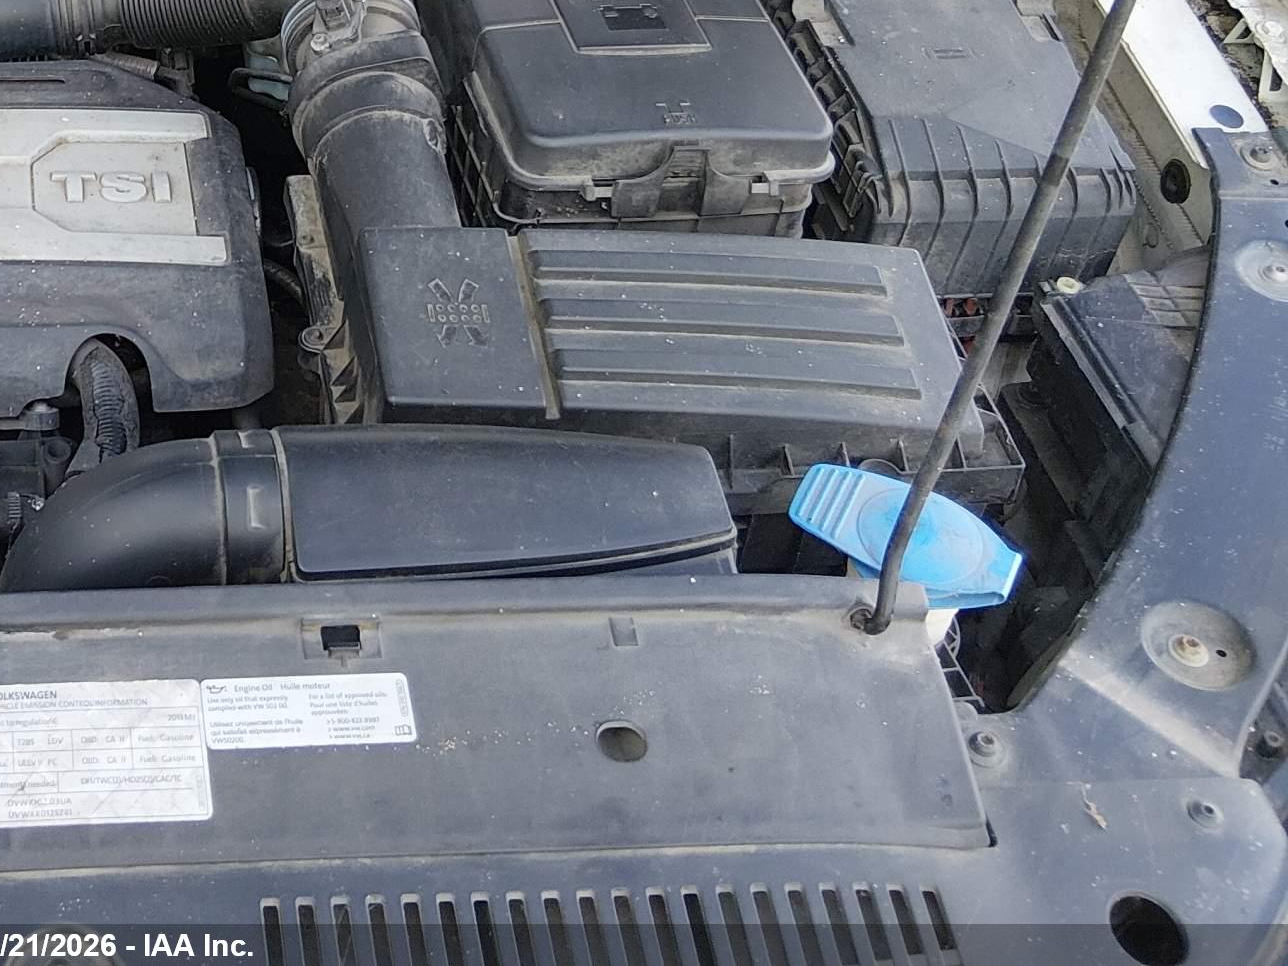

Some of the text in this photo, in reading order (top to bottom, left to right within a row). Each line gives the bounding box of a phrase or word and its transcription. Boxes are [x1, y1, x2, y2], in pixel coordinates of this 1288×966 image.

[50, 170, 172, 203] TSI
[234, 683, 273, 693] Engine Oil
